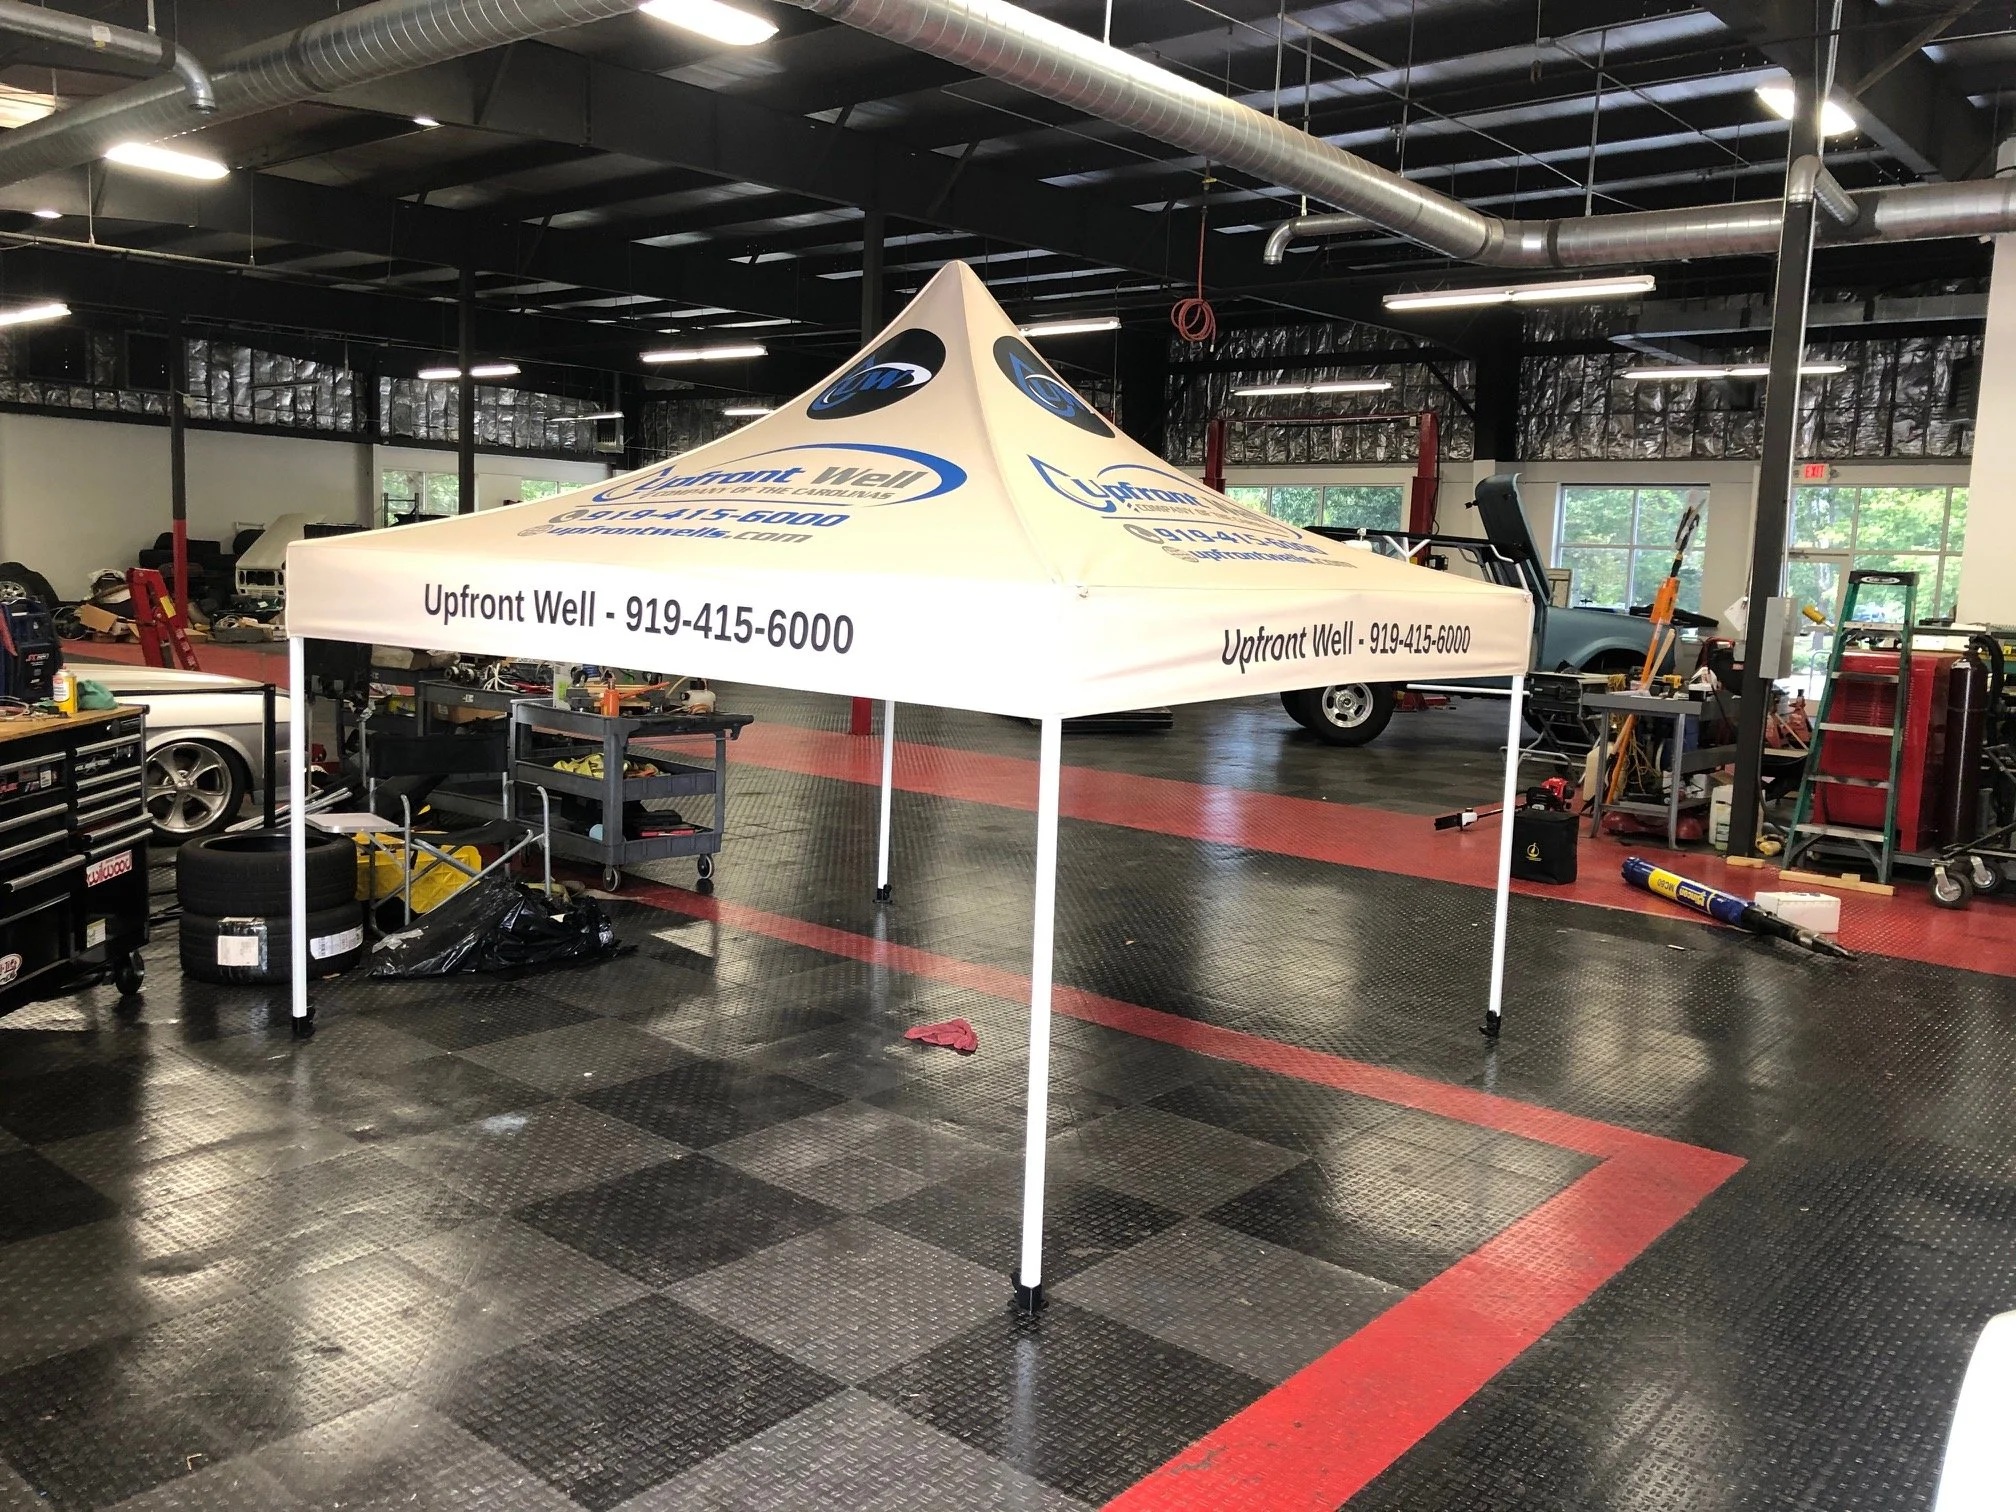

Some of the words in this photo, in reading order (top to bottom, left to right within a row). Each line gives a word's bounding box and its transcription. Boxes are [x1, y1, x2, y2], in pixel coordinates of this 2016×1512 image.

[635, 466, 806, 492] Upfront
[812, 467, 928, 488] Well
[1805, 465, 1825, 478] EXIT
[652, 488, 728, 497] COMPANY
[757, 486, 790, 495] THE
[791, 487, 895, 499] CAROLINAS
[1071, 479, 1209, 508] Upfront
[580, 508, 850, 527] 919-415-6000
[551, 525, 813, 543] upfrontwells.com
[424, 583, 525, 625] Upfront
[533, 589, 596, 627] Well
[625, 595, 855, 655] 919-415-6000
[1221, 625, 1307, 674] Upfront
[1312, 620, 1354, 657] Well
[1369, 622, 1471, 654] 919-415-6000
